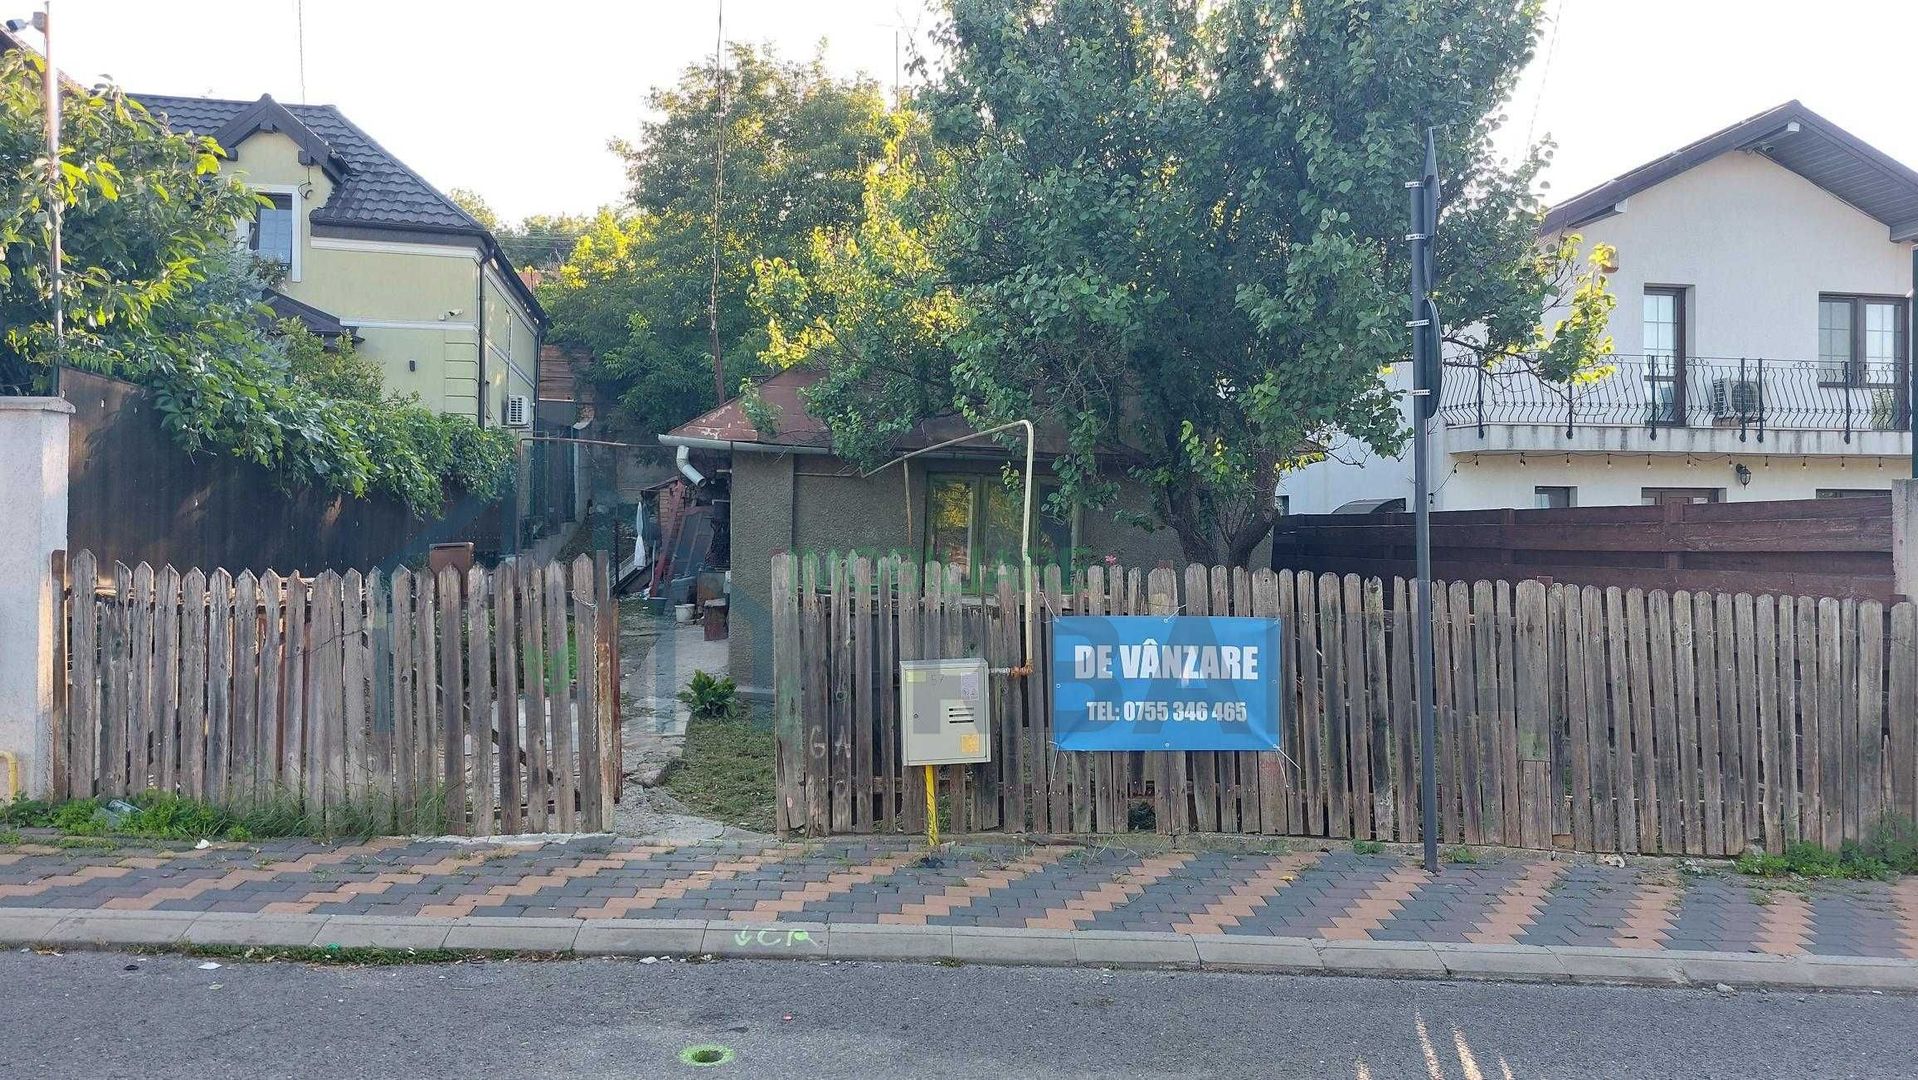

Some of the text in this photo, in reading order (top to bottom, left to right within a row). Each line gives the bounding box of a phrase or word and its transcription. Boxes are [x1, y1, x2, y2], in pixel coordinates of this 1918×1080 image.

[1074, 638, 1258, 680] DE VÂNZARE
[1087, 701, 1247, 721] TEL: 0755 346 465
